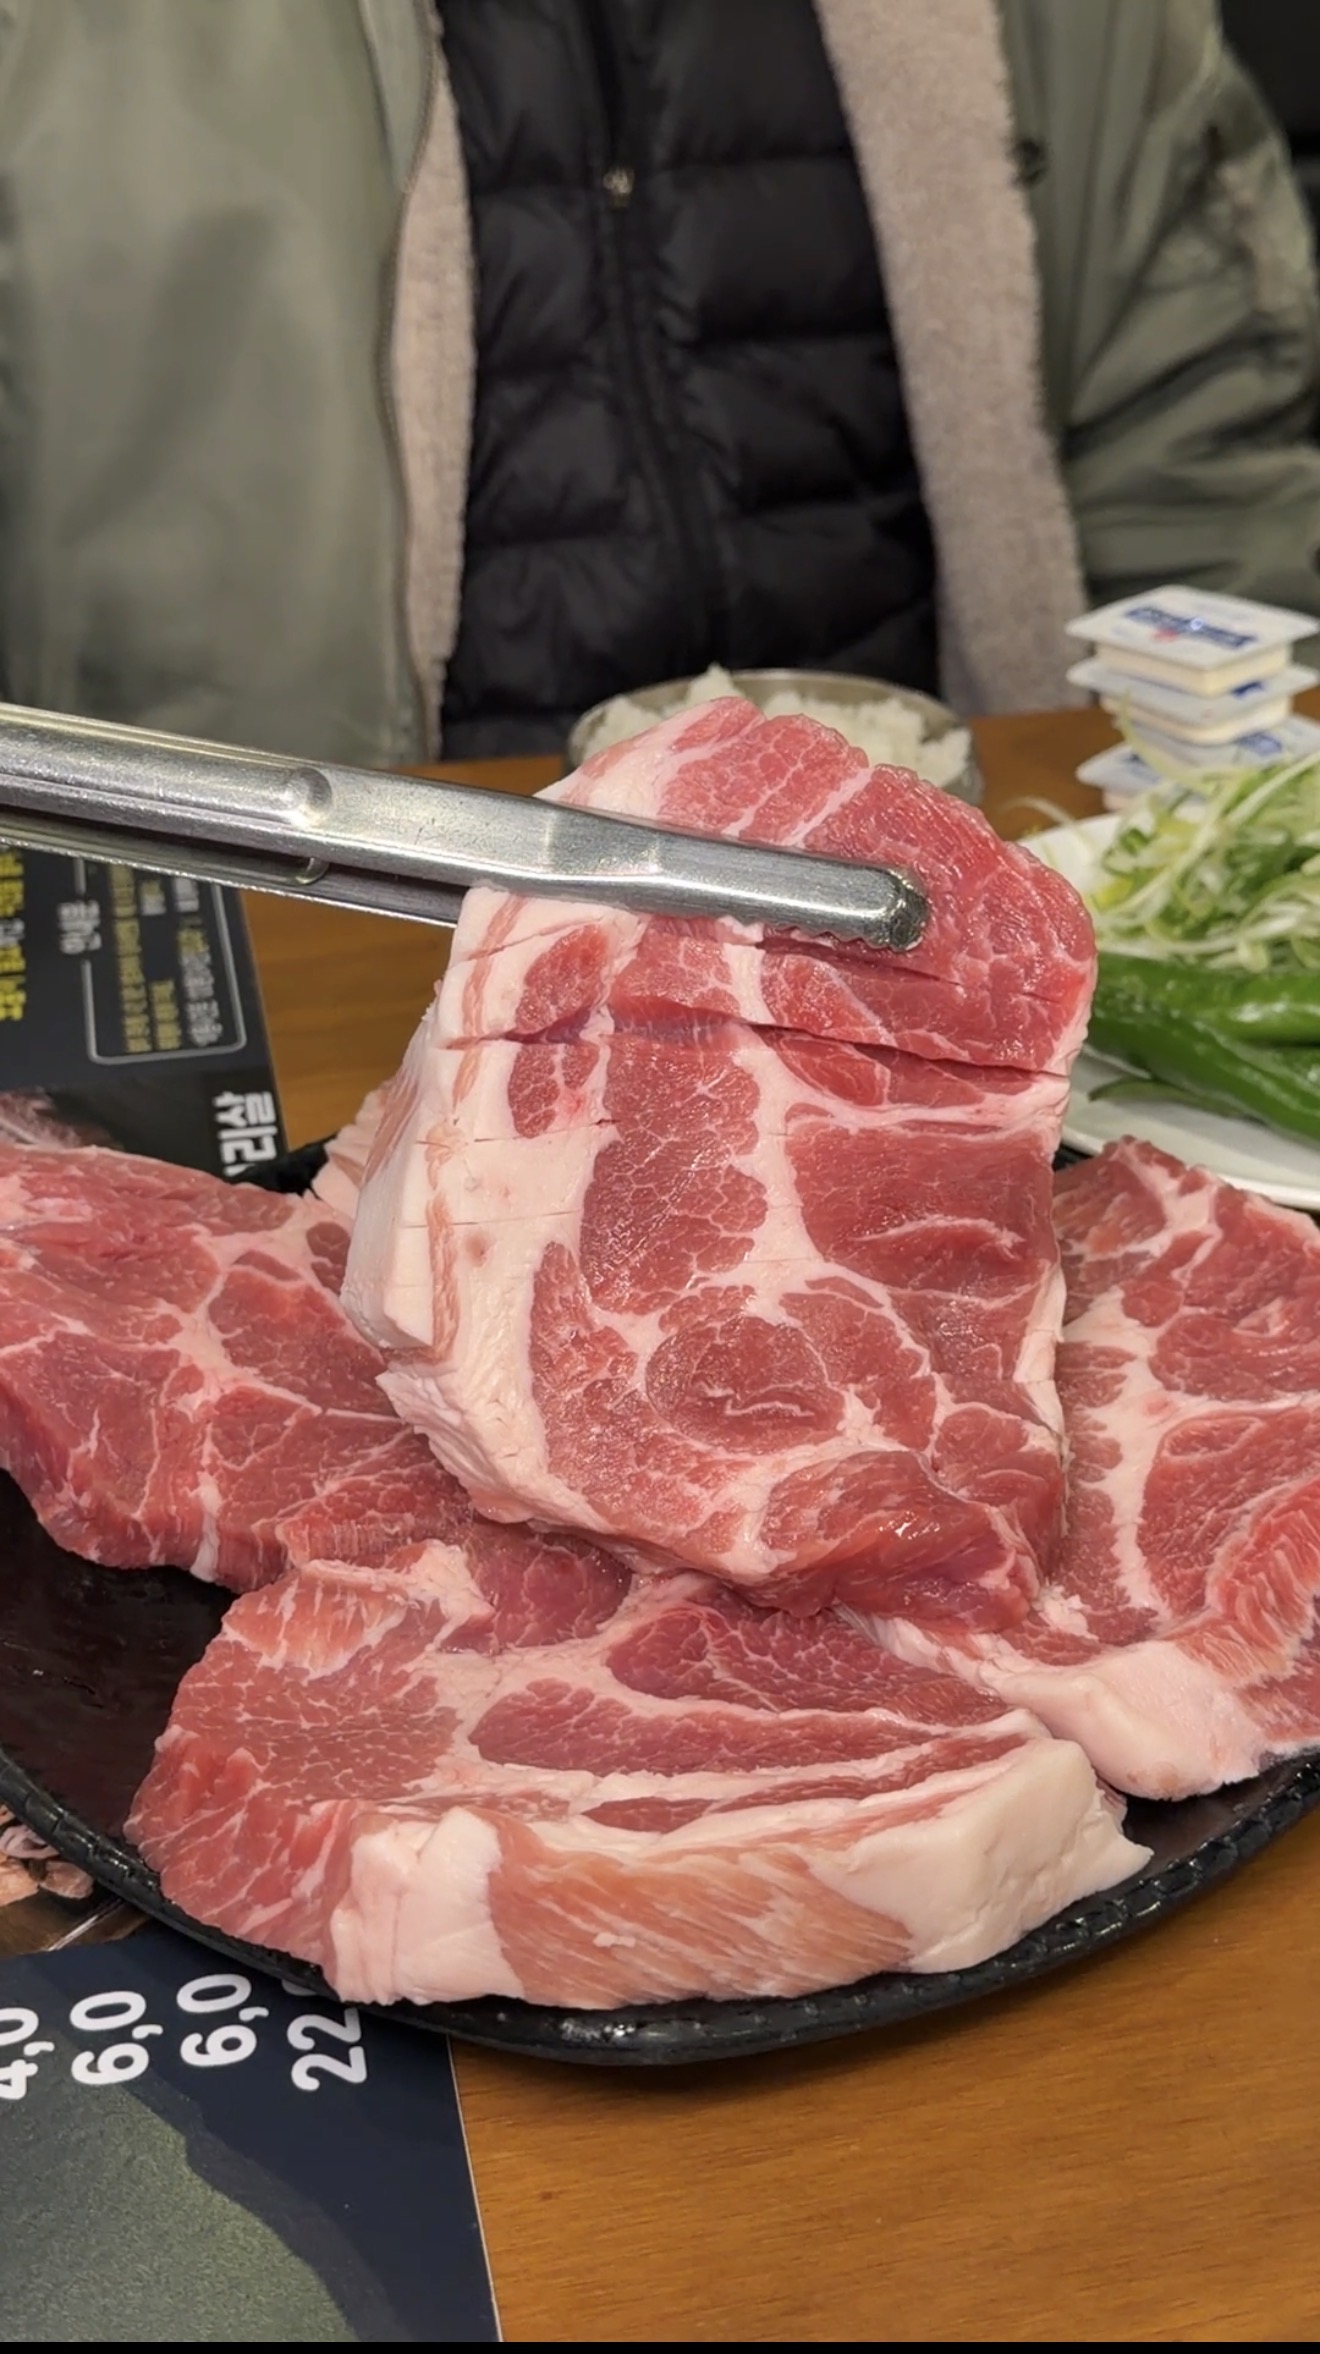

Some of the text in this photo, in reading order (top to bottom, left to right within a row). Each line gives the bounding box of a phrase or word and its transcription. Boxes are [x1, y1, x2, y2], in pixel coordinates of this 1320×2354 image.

[213, 1091, 277, 1176] 리살
[69, 1991, 163, 2085] 6,0
[177, 1974, 269, 2067] 6,0
[282, 1978, 367, 2091] 22
